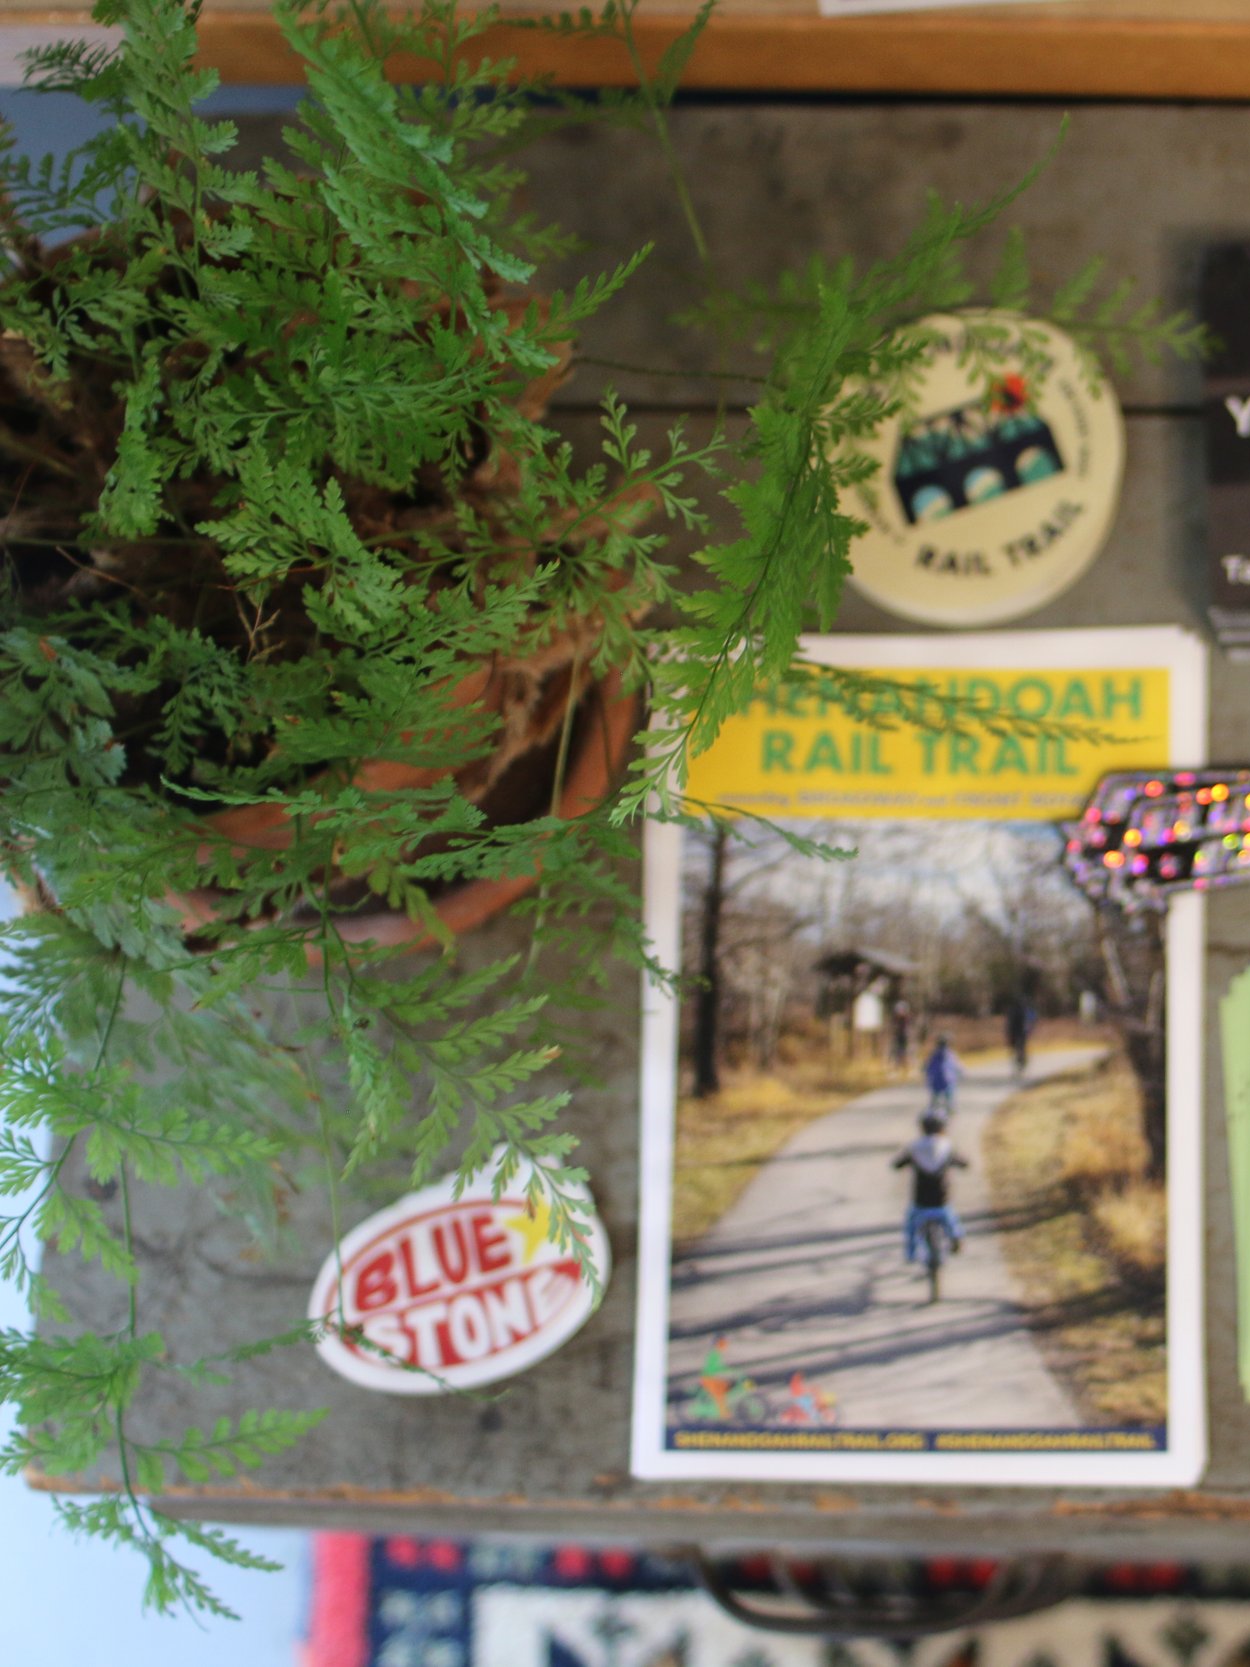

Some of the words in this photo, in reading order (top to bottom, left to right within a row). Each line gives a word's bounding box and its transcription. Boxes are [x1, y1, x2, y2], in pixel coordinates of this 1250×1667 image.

[916, 544, 991, 575] RAIL
[1004, 501, 1083, 568] TRAIL
[760, 730, 893, 776] RAIL
[914, 731, 1077, 776] TRAIL
[355, 1213, 512, 1311] BLUE
